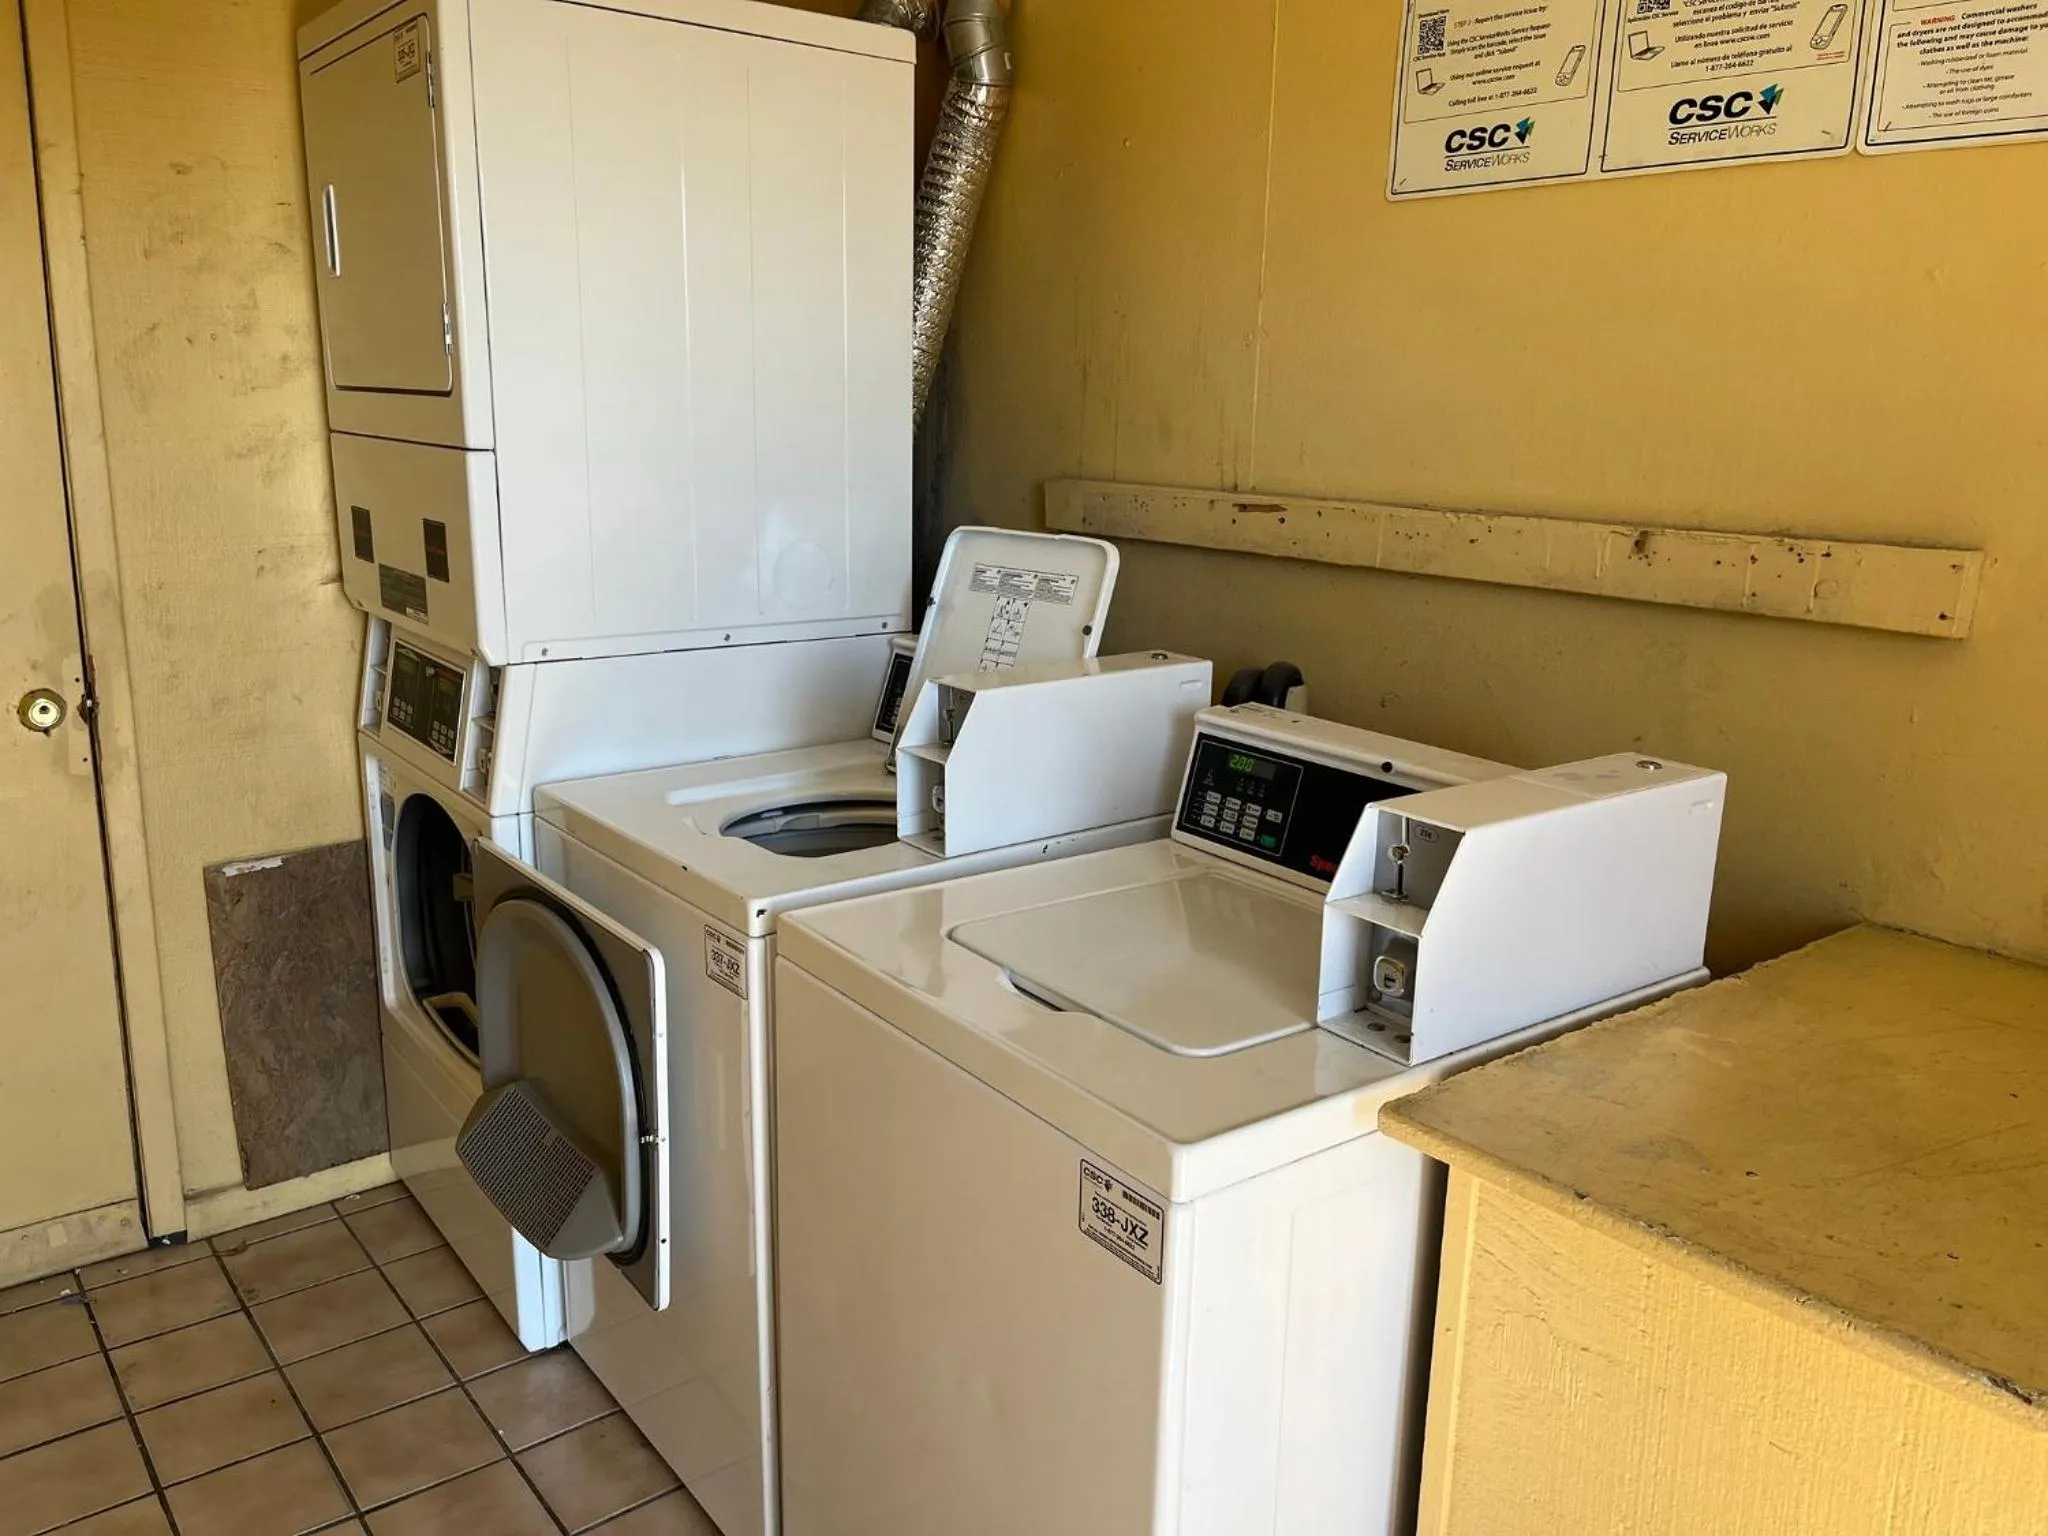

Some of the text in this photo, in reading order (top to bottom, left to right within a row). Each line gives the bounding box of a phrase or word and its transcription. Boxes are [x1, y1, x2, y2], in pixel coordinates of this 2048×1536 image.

[1961, 7, 2005, 19] Commercial
[2006, 4, 2038, 12] washers
[1961, 19, 1996, 29] designed
[1909, 37, 1942, 46] following
[1998, 26, 2028, 35] damage
[1955, 42, 1970, 50] well
[1669, 91, 1754, 125] CSC
[1445, 124, 1511, 153] CSC
[1083, 1166, 1104, 1185] CSC
[1091, 1196, 1149, 1248] 338-JXZ
